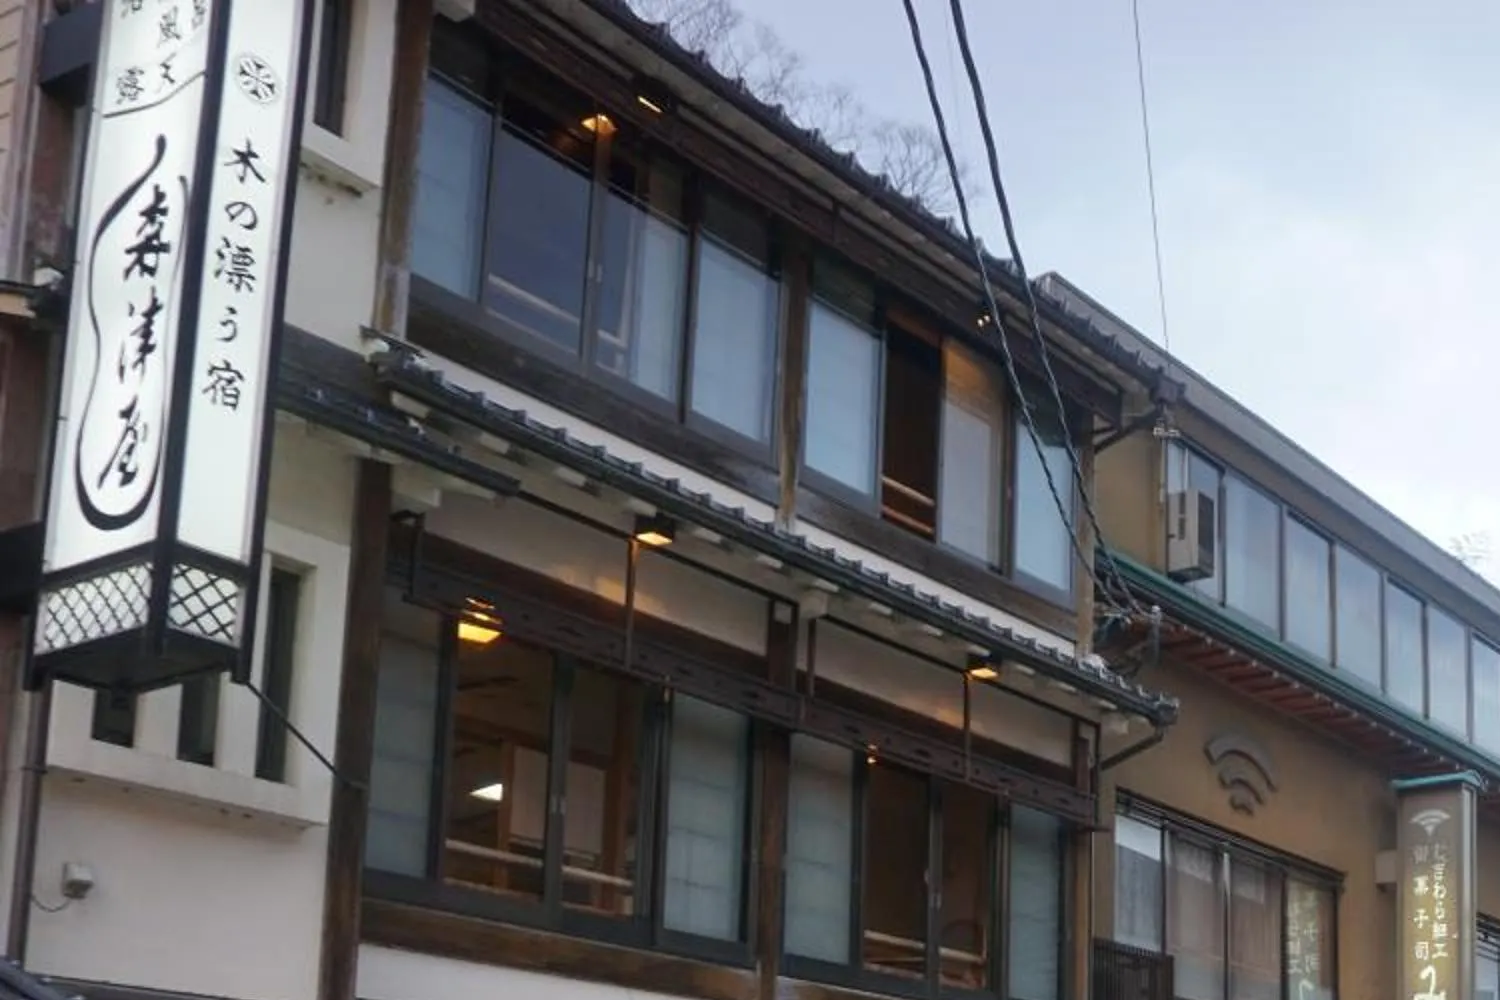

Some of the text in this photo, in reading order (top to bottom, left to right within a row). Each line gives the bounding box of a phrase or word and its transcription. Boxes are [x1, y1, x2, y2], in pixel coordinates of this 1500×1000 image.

[202, 138, 267, 411] 木の漂う宿
